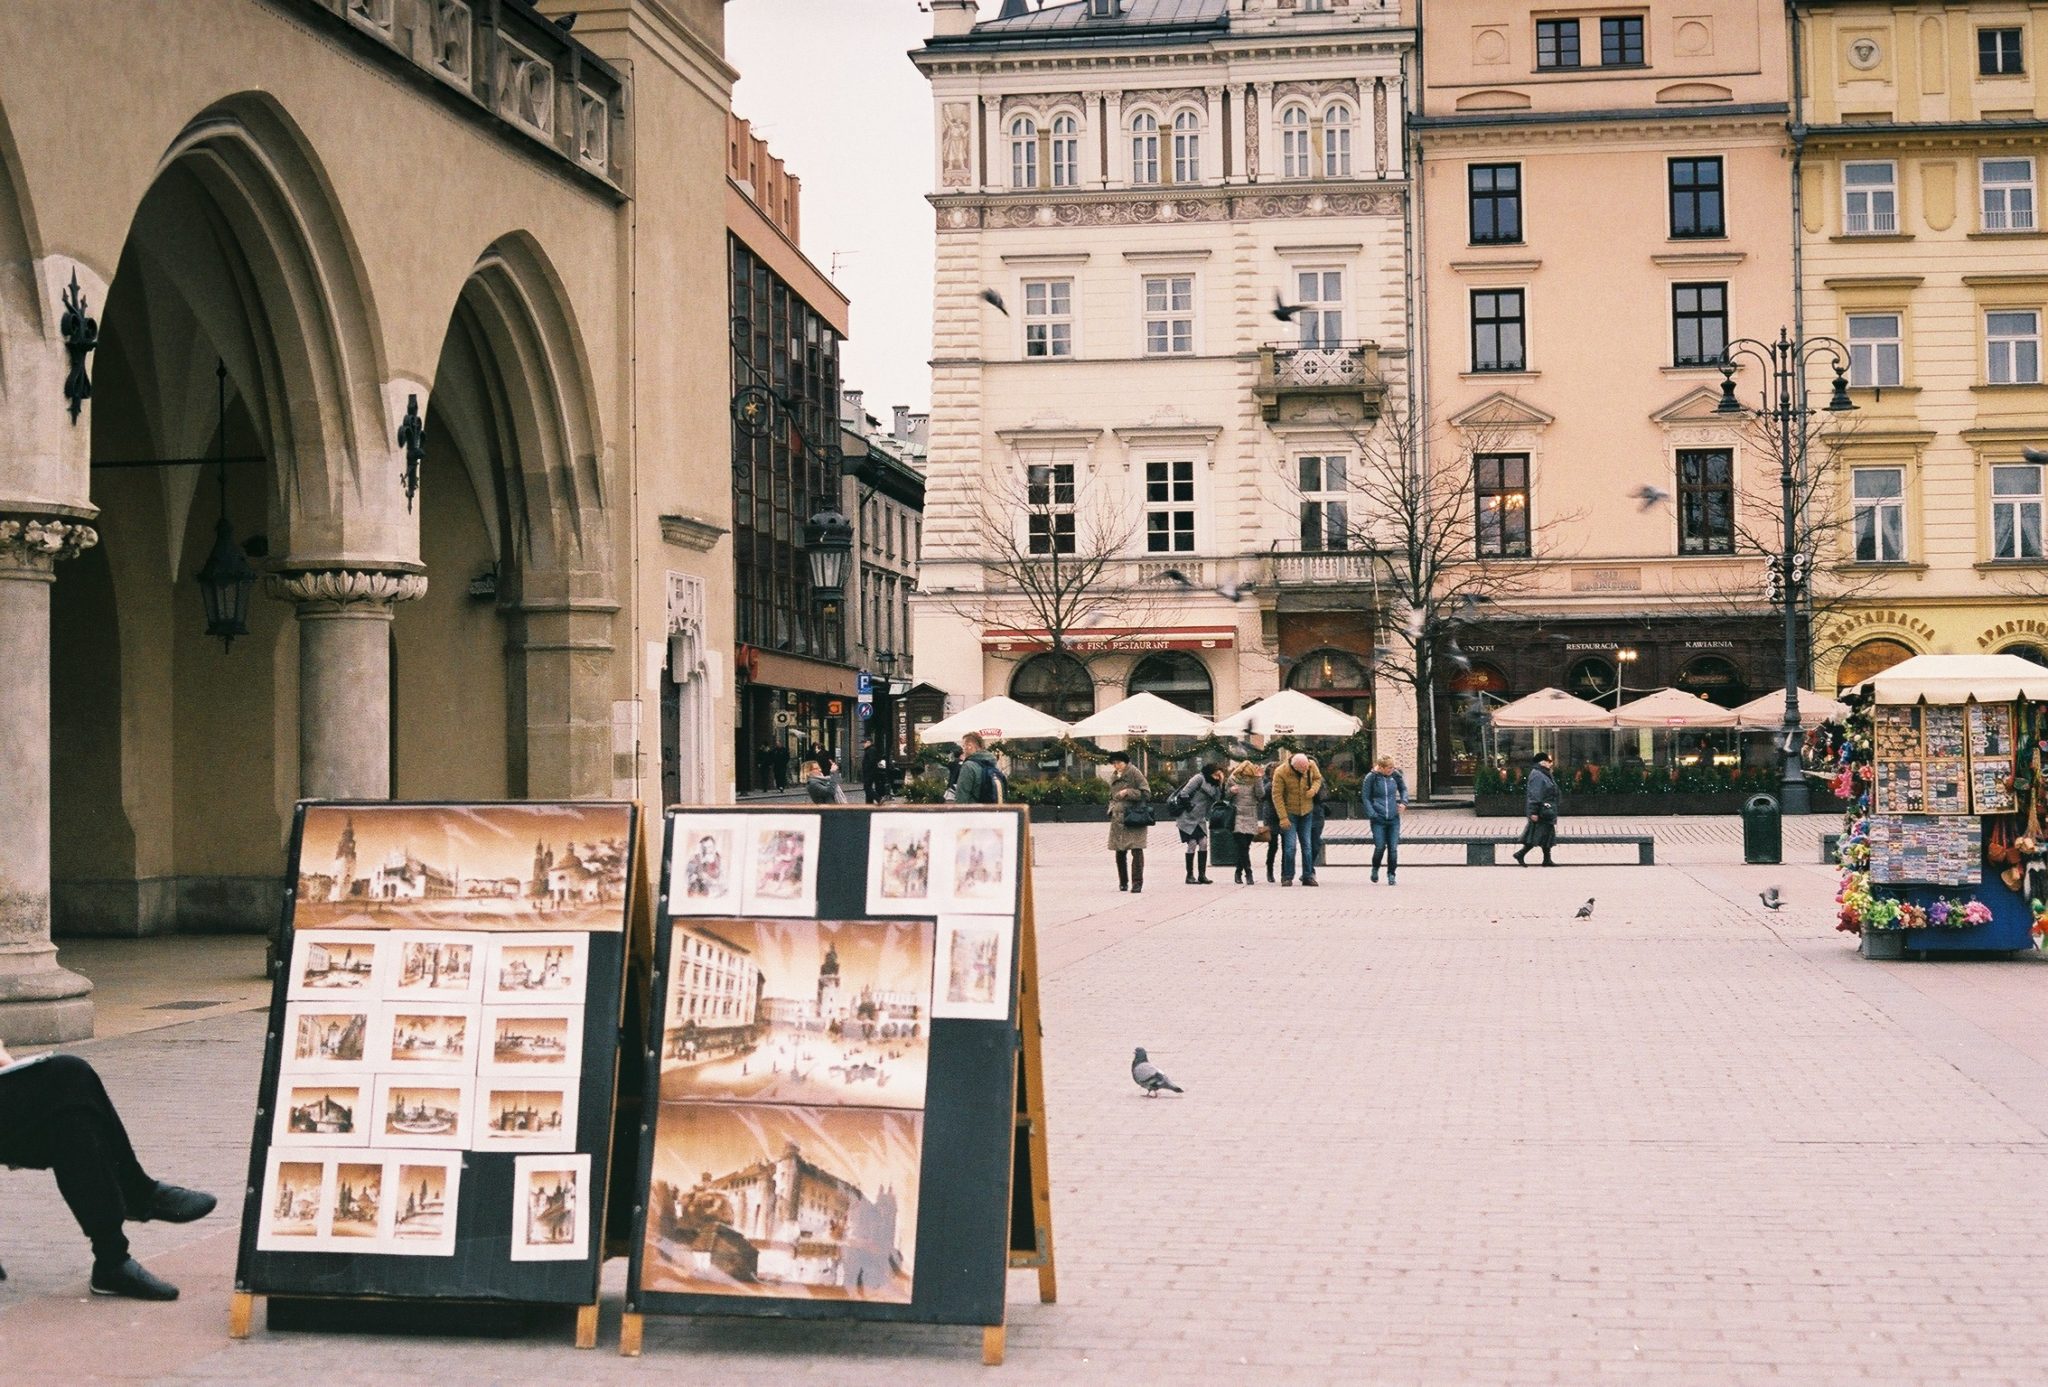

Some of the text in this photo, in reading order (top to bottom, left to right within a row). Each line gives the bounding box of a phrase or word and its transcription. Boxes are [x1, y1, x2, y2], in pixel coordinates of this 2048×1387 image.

[1828, 611, 1936, 643] RESTAURACJA
[1976, 619, 2048, 648] APARTHO
[1112, 641, 1169, 650] RESTAURANT
[1566, 642, 1619, 650] RESTAURACJA
[860, 675, 869, 689] P
